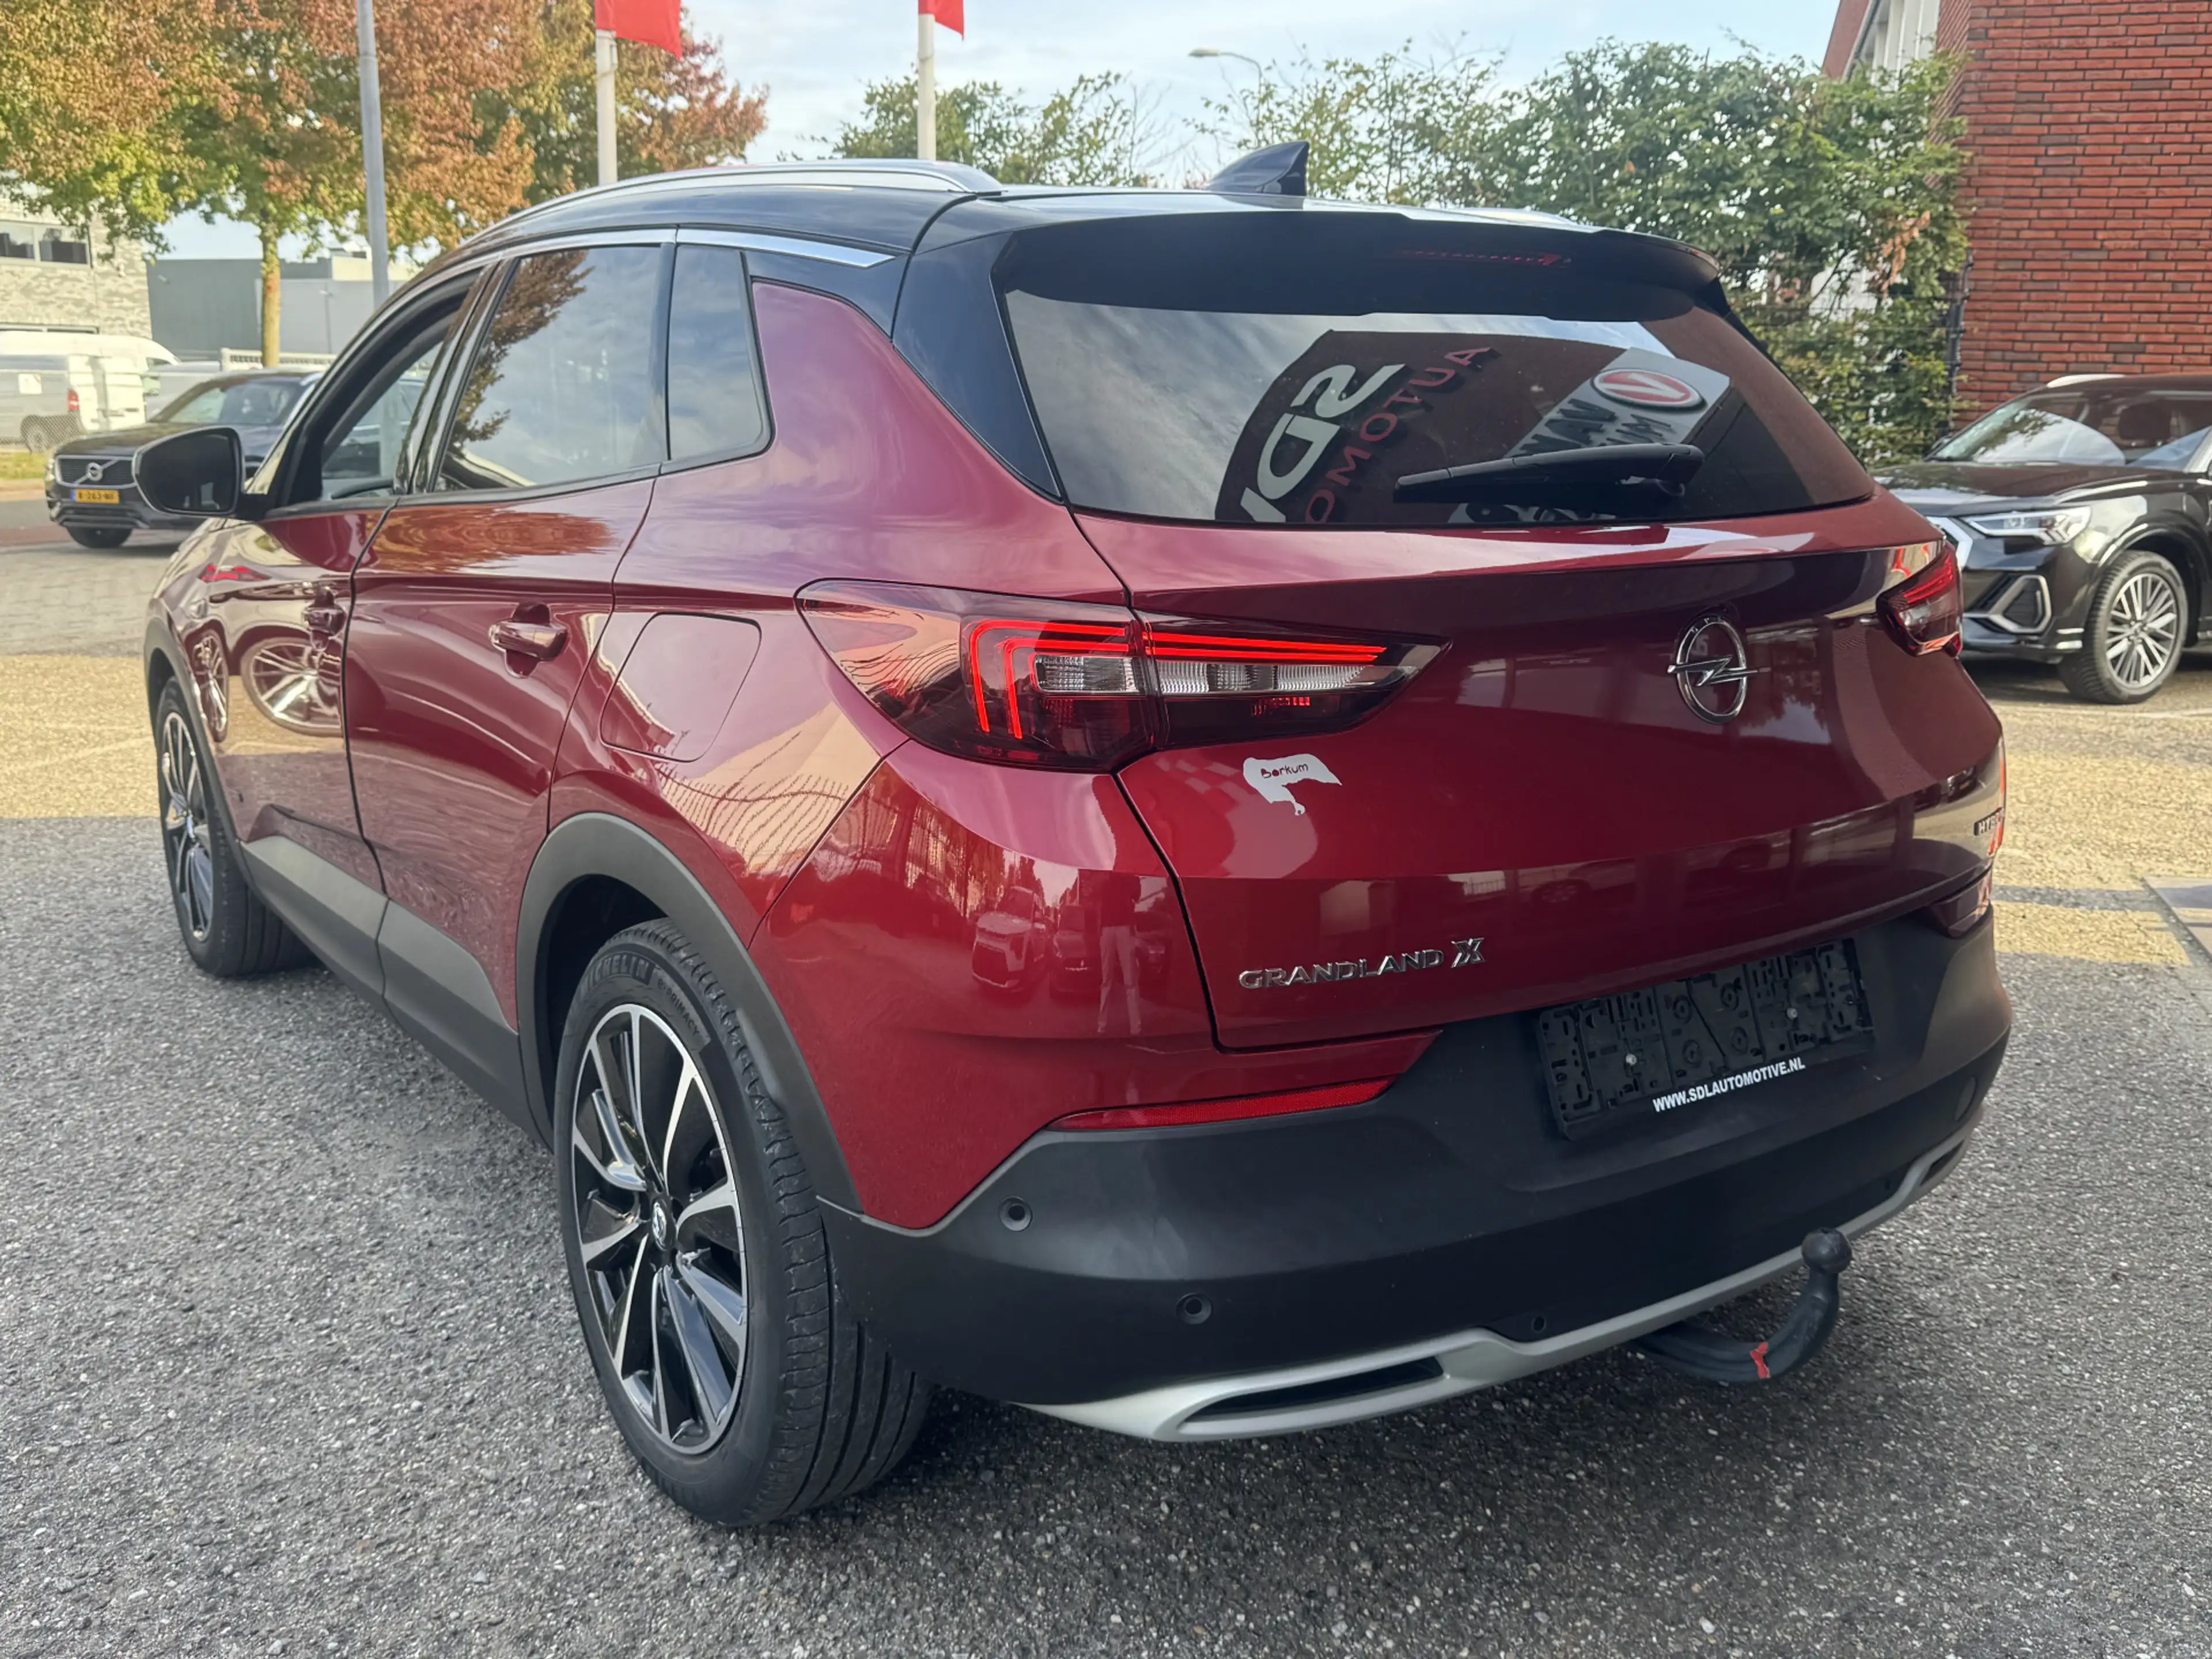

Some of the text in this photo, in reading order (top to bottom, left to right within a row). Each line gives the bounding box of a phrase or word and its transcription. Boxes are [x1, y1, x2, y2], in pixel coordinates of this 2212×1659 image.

[1260, 763, 1309, 779] Borkum
[1238, 937, 1484, 989] GRANDLAND X
[1653, 1056, 1805, 1112] WWW.SDLAUTOMOTIVE.NL
